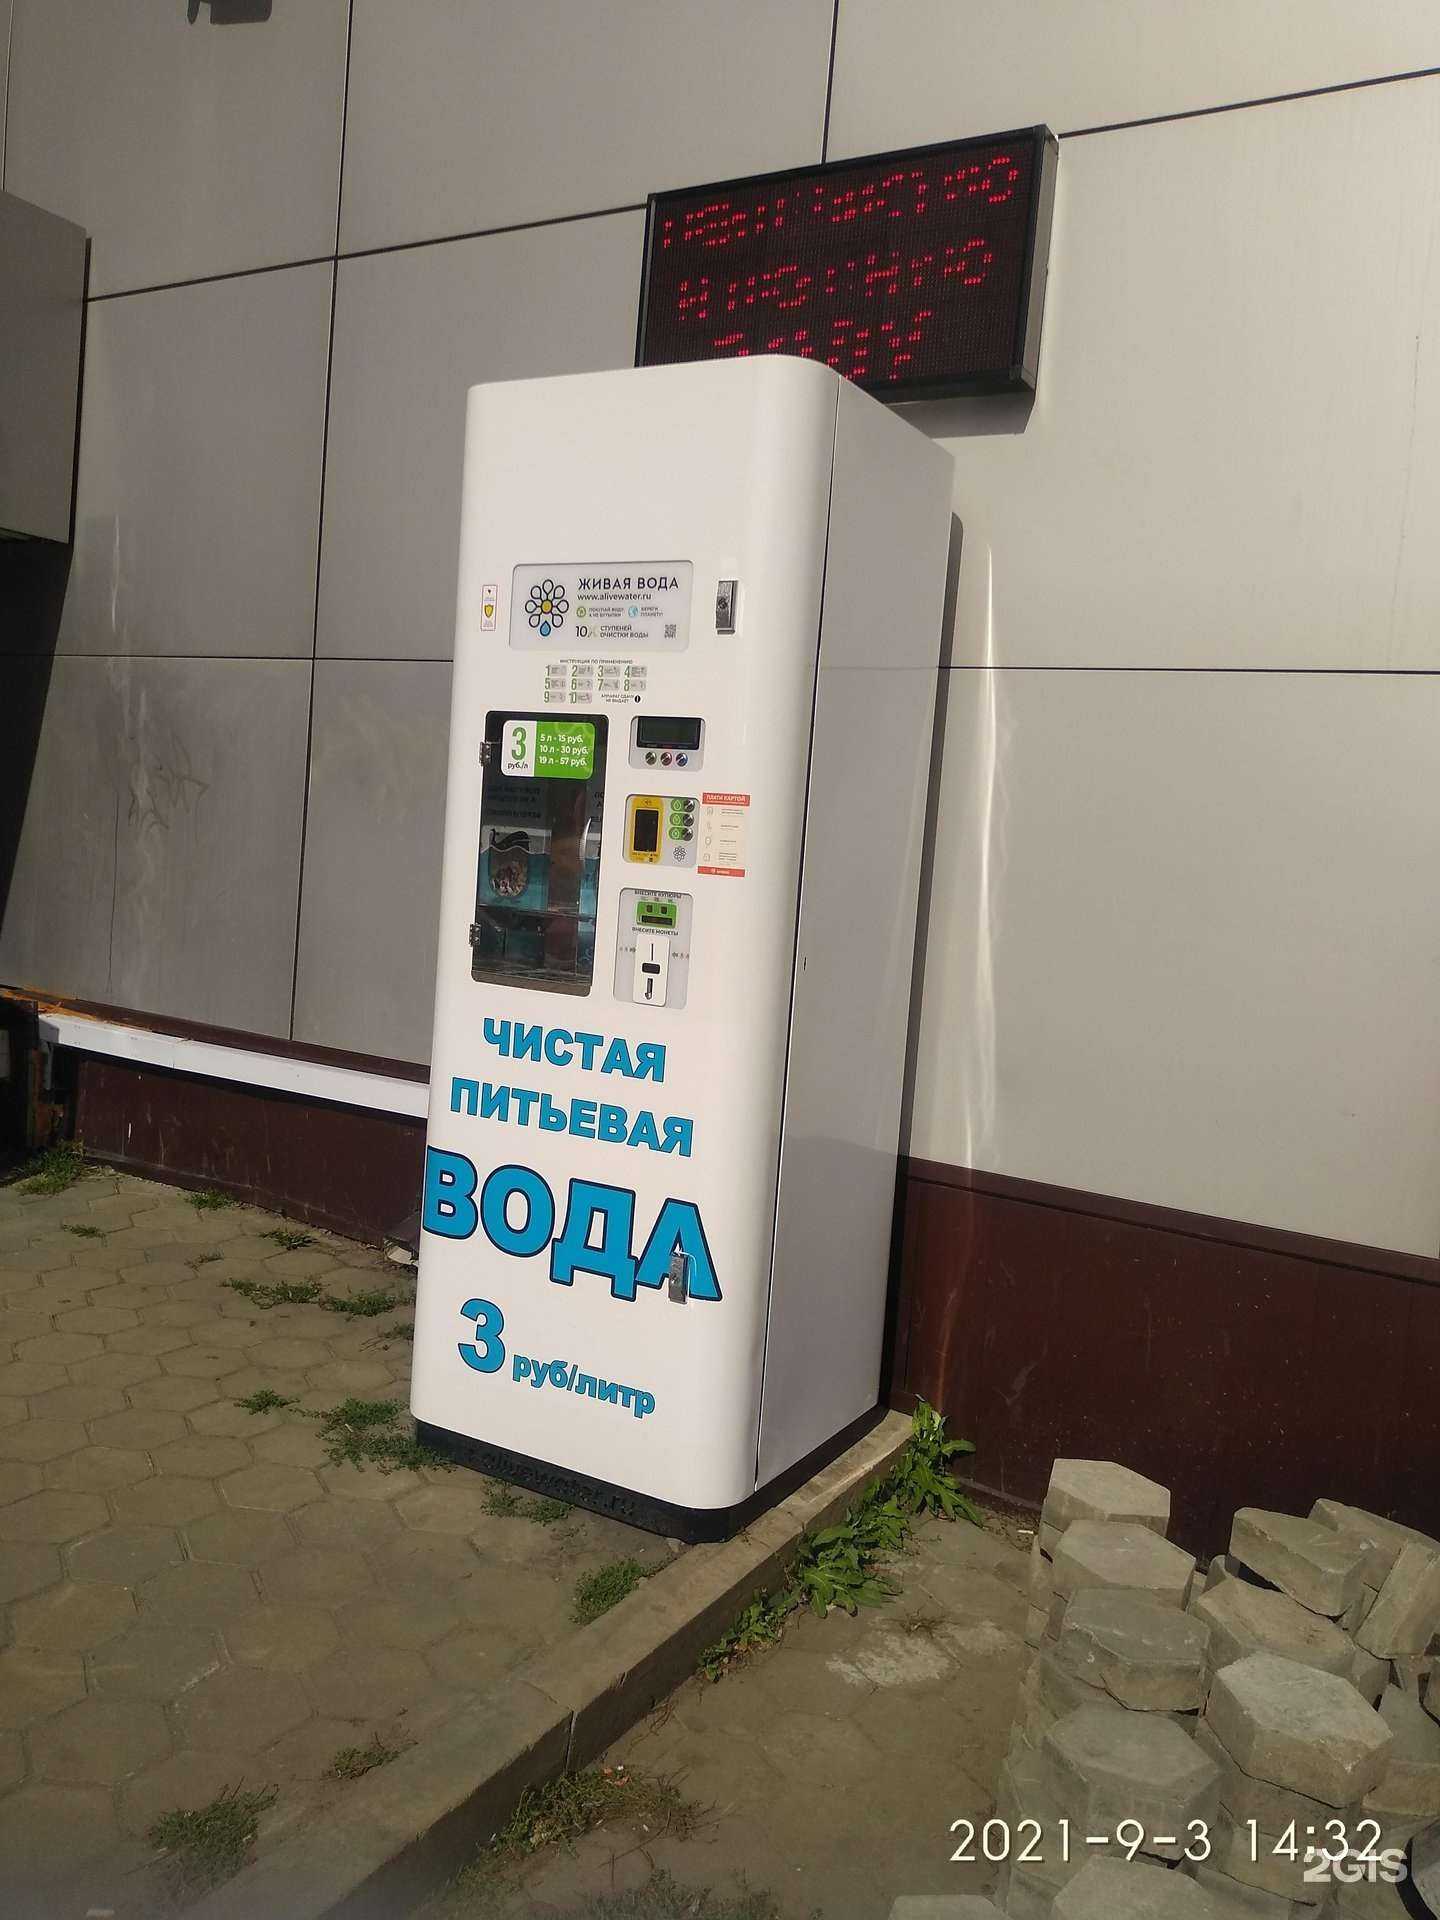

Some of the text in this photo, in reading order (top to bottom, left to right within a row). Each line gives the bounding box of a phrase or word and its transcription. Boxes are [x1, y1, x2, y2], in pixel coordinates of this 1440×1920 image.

[577, 576, 679, 590] ЖИВАЯ ВОДА
[577, 592, 651, 601] www.alivewater.ru
[576, 625, 588, 638] 10
[545, 665, 551, 676] 1
[571, 665, 578, 677] 2
[597, 665, 604, 677] 3
[624, 665, 630, 678] 4
[544, 678, 551, 689] 5
[571, 678, 577, 690] 6
[597, 679, 604, 691] 7
[623, 679, 630, 691] 8
[543, 691, 550, 703] 9
[569, 692, 577, 703] 10
[511, 727, 527, 760] 3
[539, 745, 548, 753] 10
[560, 746, 570, 754] 30
[507, 760, 529, 770] руб./л
[539, 756, 547, 764] 19
[560, 757, 569, 765] 57
[483, 1017, 667, 1083] ЧИСТАЯ
[450, 1076, 694, 1158] ПИТЬЕВАЯ
[422, 1144, 723, 1302] ВОДА
[457, 1298, 656, 1419] 3 руб/литр
